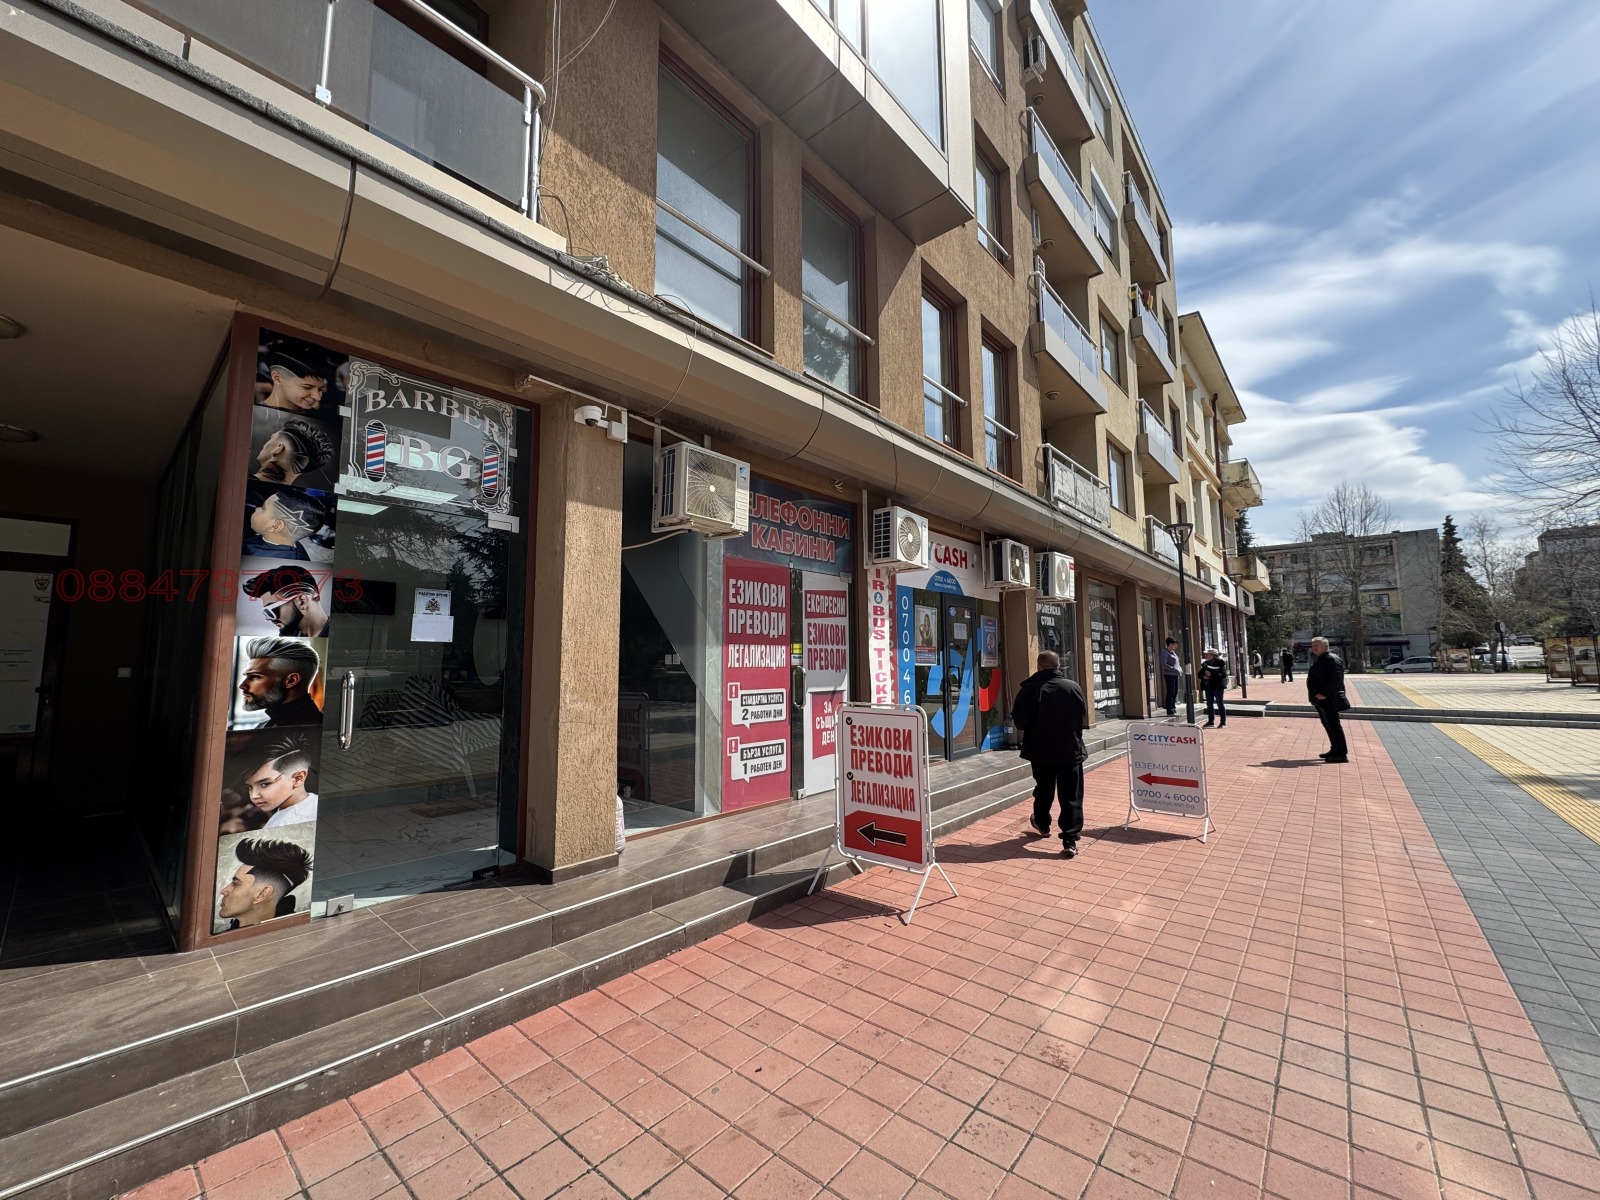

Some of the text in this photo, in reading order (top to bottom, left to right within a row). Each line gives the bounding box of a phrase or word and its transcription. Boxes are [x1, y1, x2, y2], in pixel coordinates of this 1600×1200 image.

[364, 389, 501, 446] BARBER
[397, 434, 473, 480] BG
[751, 522, 836, 563] КАБИНИ
[872, 568, 884, 591] IR
[728, 578, 786, 608] ЕЗИКОВИ
[806, 593, 846, 615] ЕКСПРЕСНИ
[728, 608, 786, 639] ПРЕВОДИ
[807, 622, 846, 646] ЕЗИКОВИ
[872, 605, 886, 640] BUS
[727, 643, 786, 670] ЛЕГАЛИЗАЦИЯ
[807, 647, 847, 673] ПРЕВОДИ
[873, 647, 888, 704] TICKE
[742, 694, 783, 706] СТАНДАРТНА УСЛУГА
[823, 701, 833, 714] ЗА
[742, 708, 783, 720] 2 РАБОТНИ ДНИ
[821, 730, 835, 746] ДЕН
[850, 724, 913, 753] ЕЗИКОВИ
[1147, 734, 1197, 745] CITYCASH
[742, 744, 782, 760] БЪРЗА УСЛУГА
[850, 748, 914, 780] ПРЕВОДИ
[742, 760, 783, 774] 1 РАБОТЕН ДЕН
[1134, 761, 1198, 774] ВЗЕМИ СЕГА!
[851, 779, 916, 814] ЛЕГАЛИЗАЦИЯ
[1136, 789, 1161, 799] 0700
[1173, 793, 1200, 804] 6000
[1141, 798, 1195, 810] www.citycash.bg
